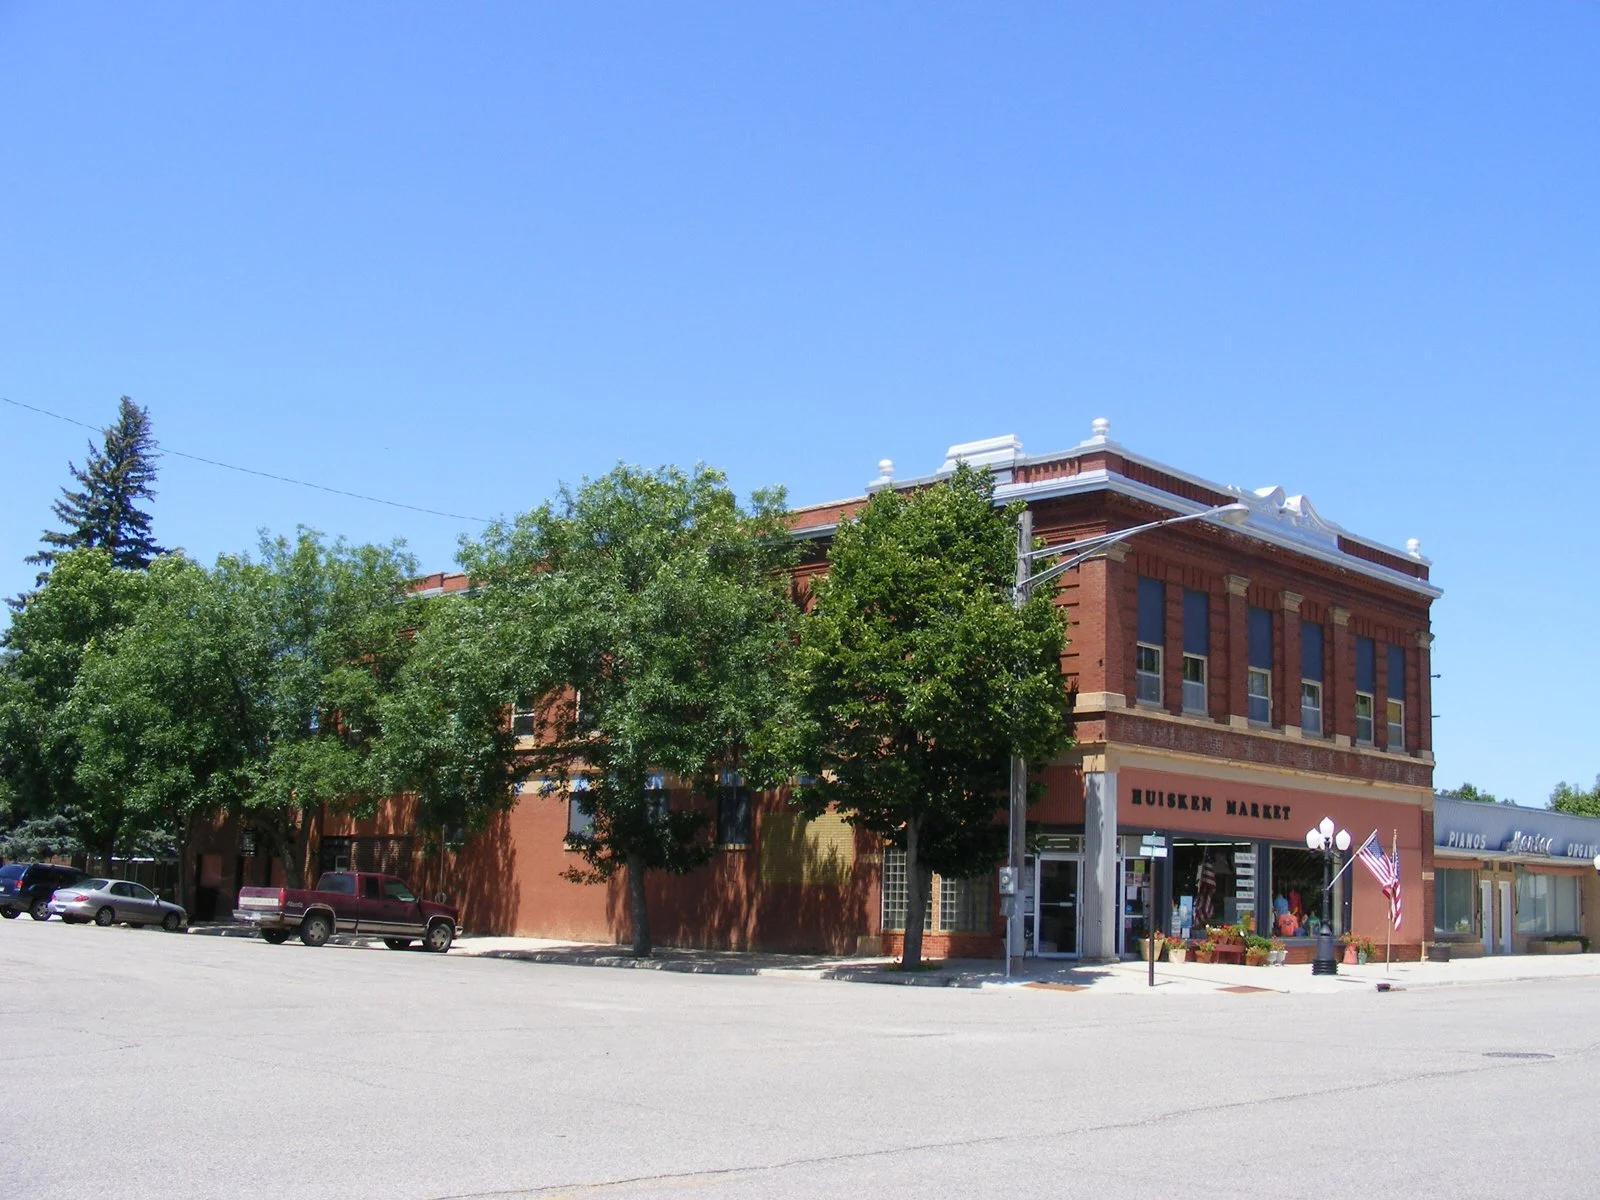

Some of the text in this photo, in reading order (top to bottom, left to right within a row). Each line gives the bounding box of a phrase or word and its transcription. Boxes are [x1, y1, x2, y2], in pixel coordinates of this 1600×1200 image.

[1131, 789, 1291, 820] HUISKEN MARKET
[1448, 831, 1486, 849] PIANOS
[1567, 843, 1599, 859] ORGANS
